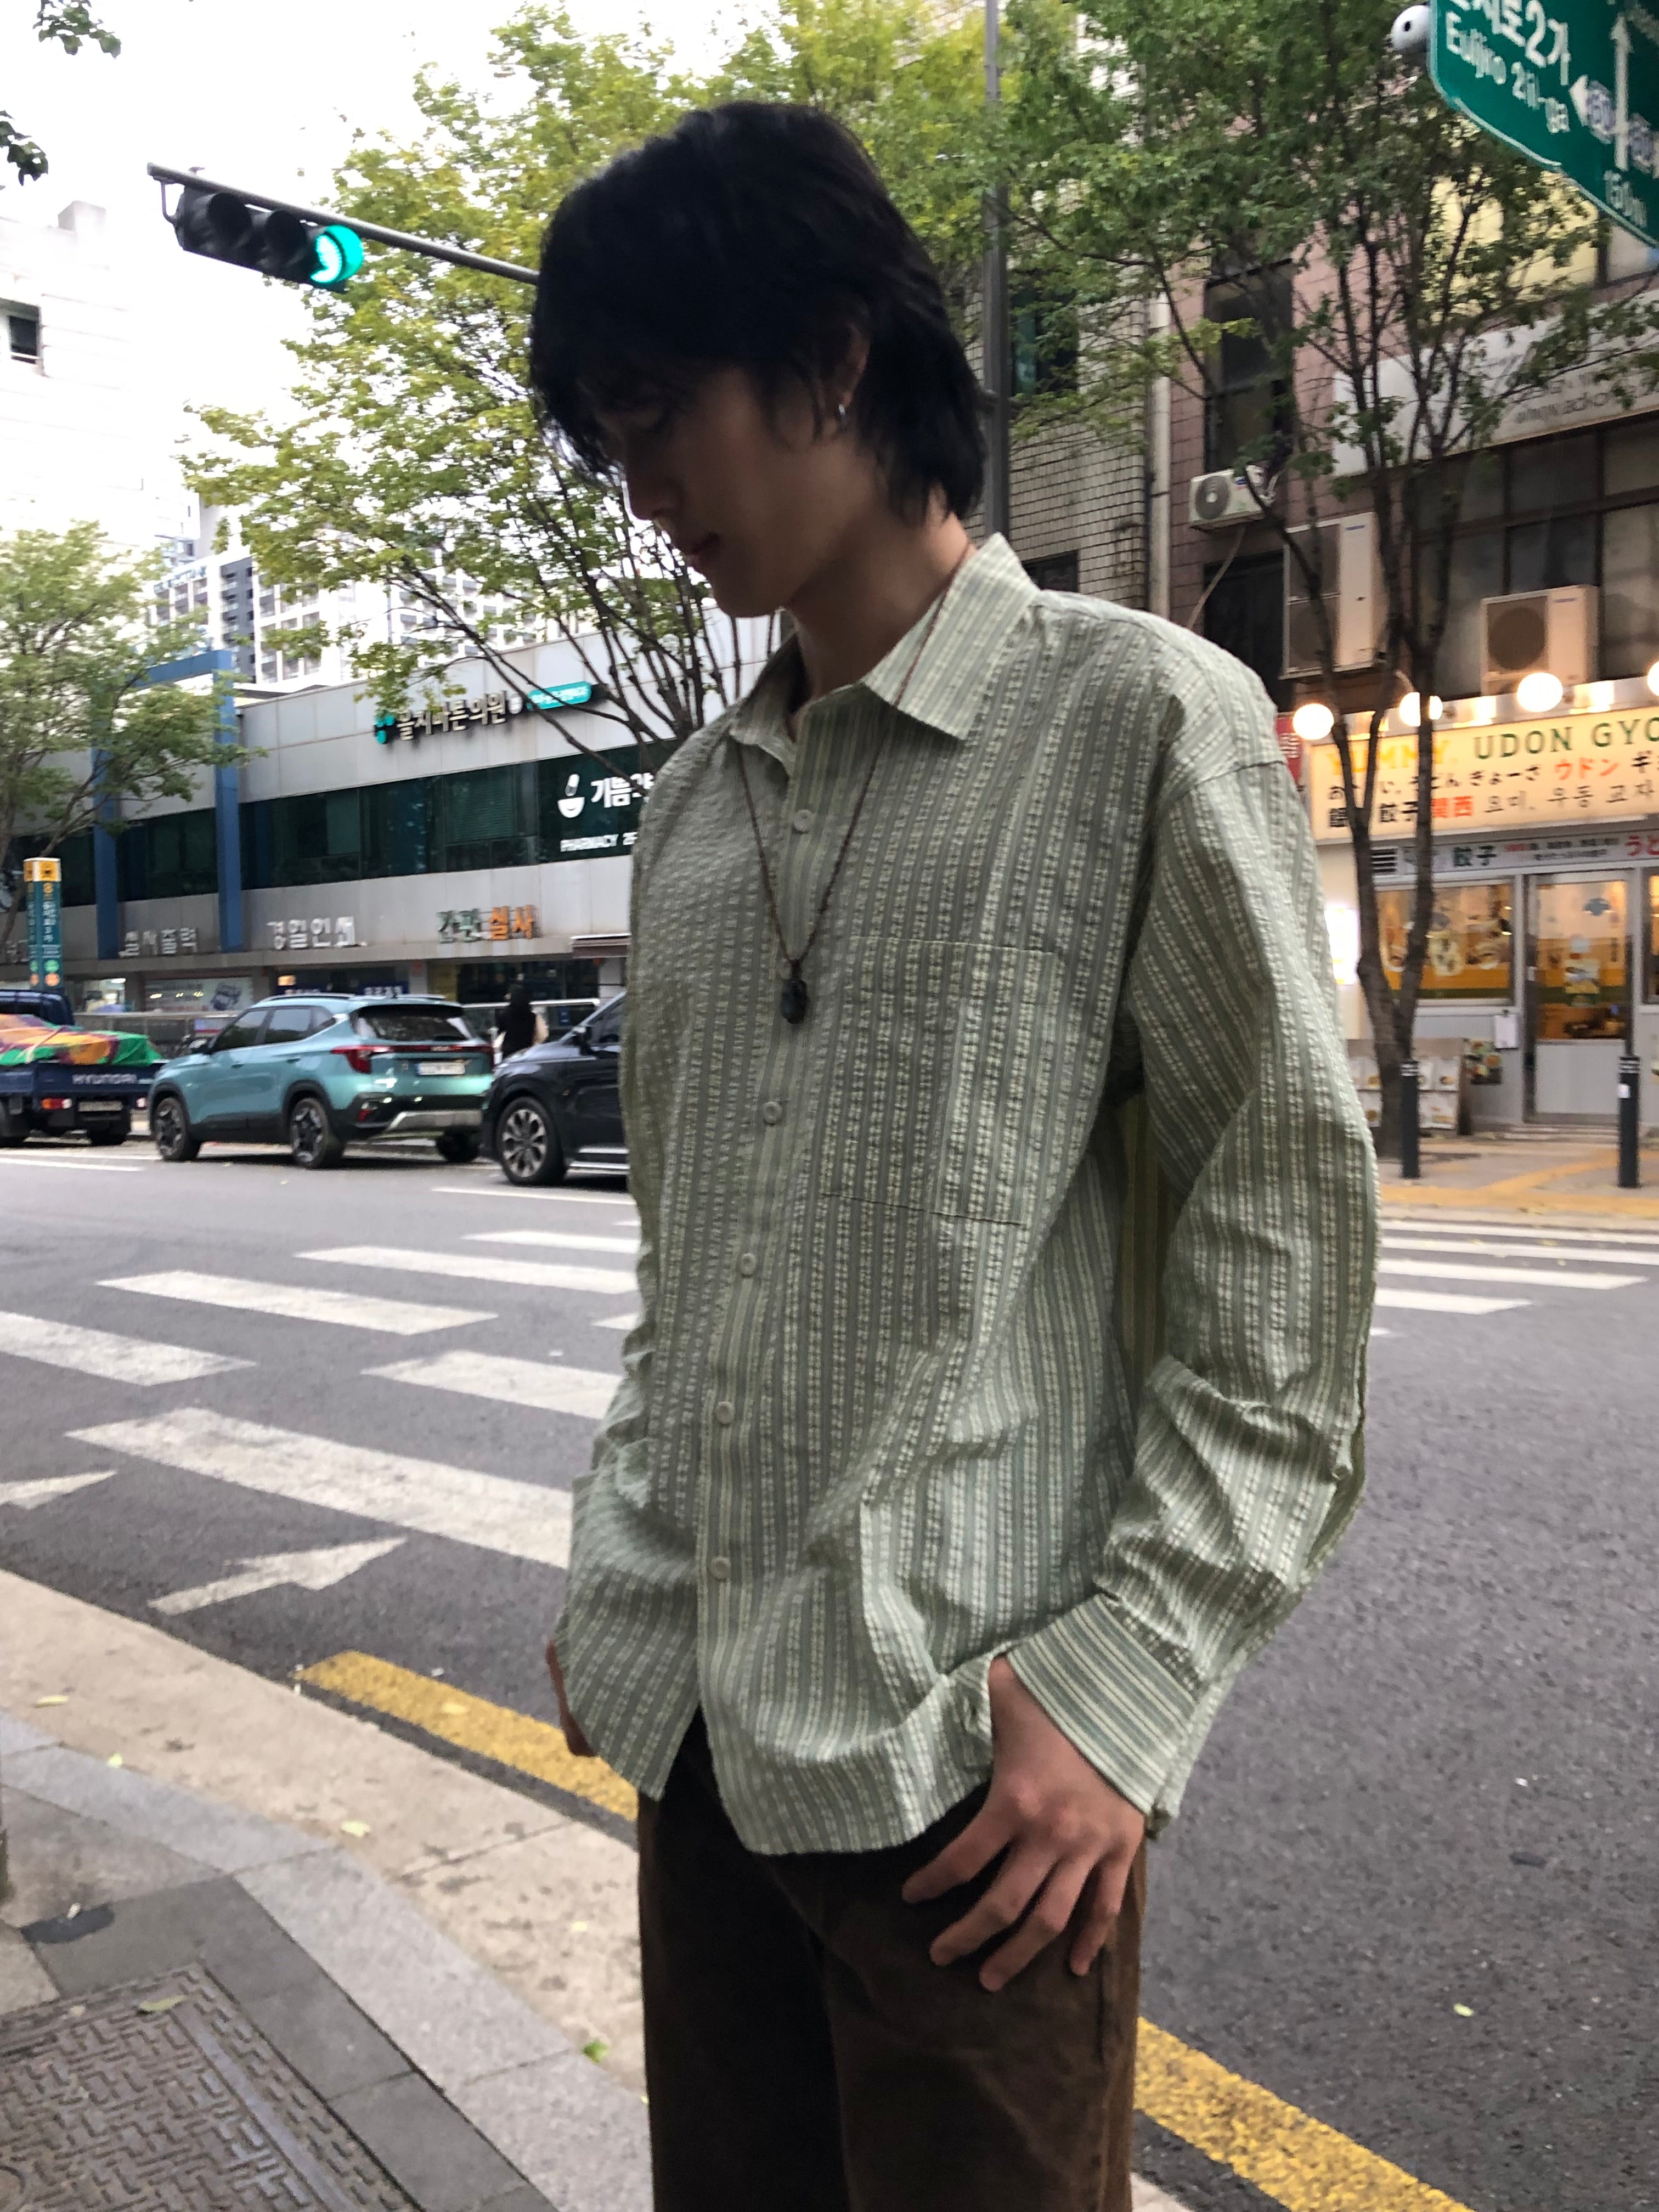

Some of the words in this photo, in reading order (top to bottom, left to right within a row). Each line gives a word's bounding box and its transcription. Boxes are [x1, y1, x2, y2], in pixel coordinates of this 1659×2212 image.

[1448, 0, 1571, 86] 로2가
[1474, 726, 1573, 759] UDON
[1554, 757, 1620, 781] ウドン
